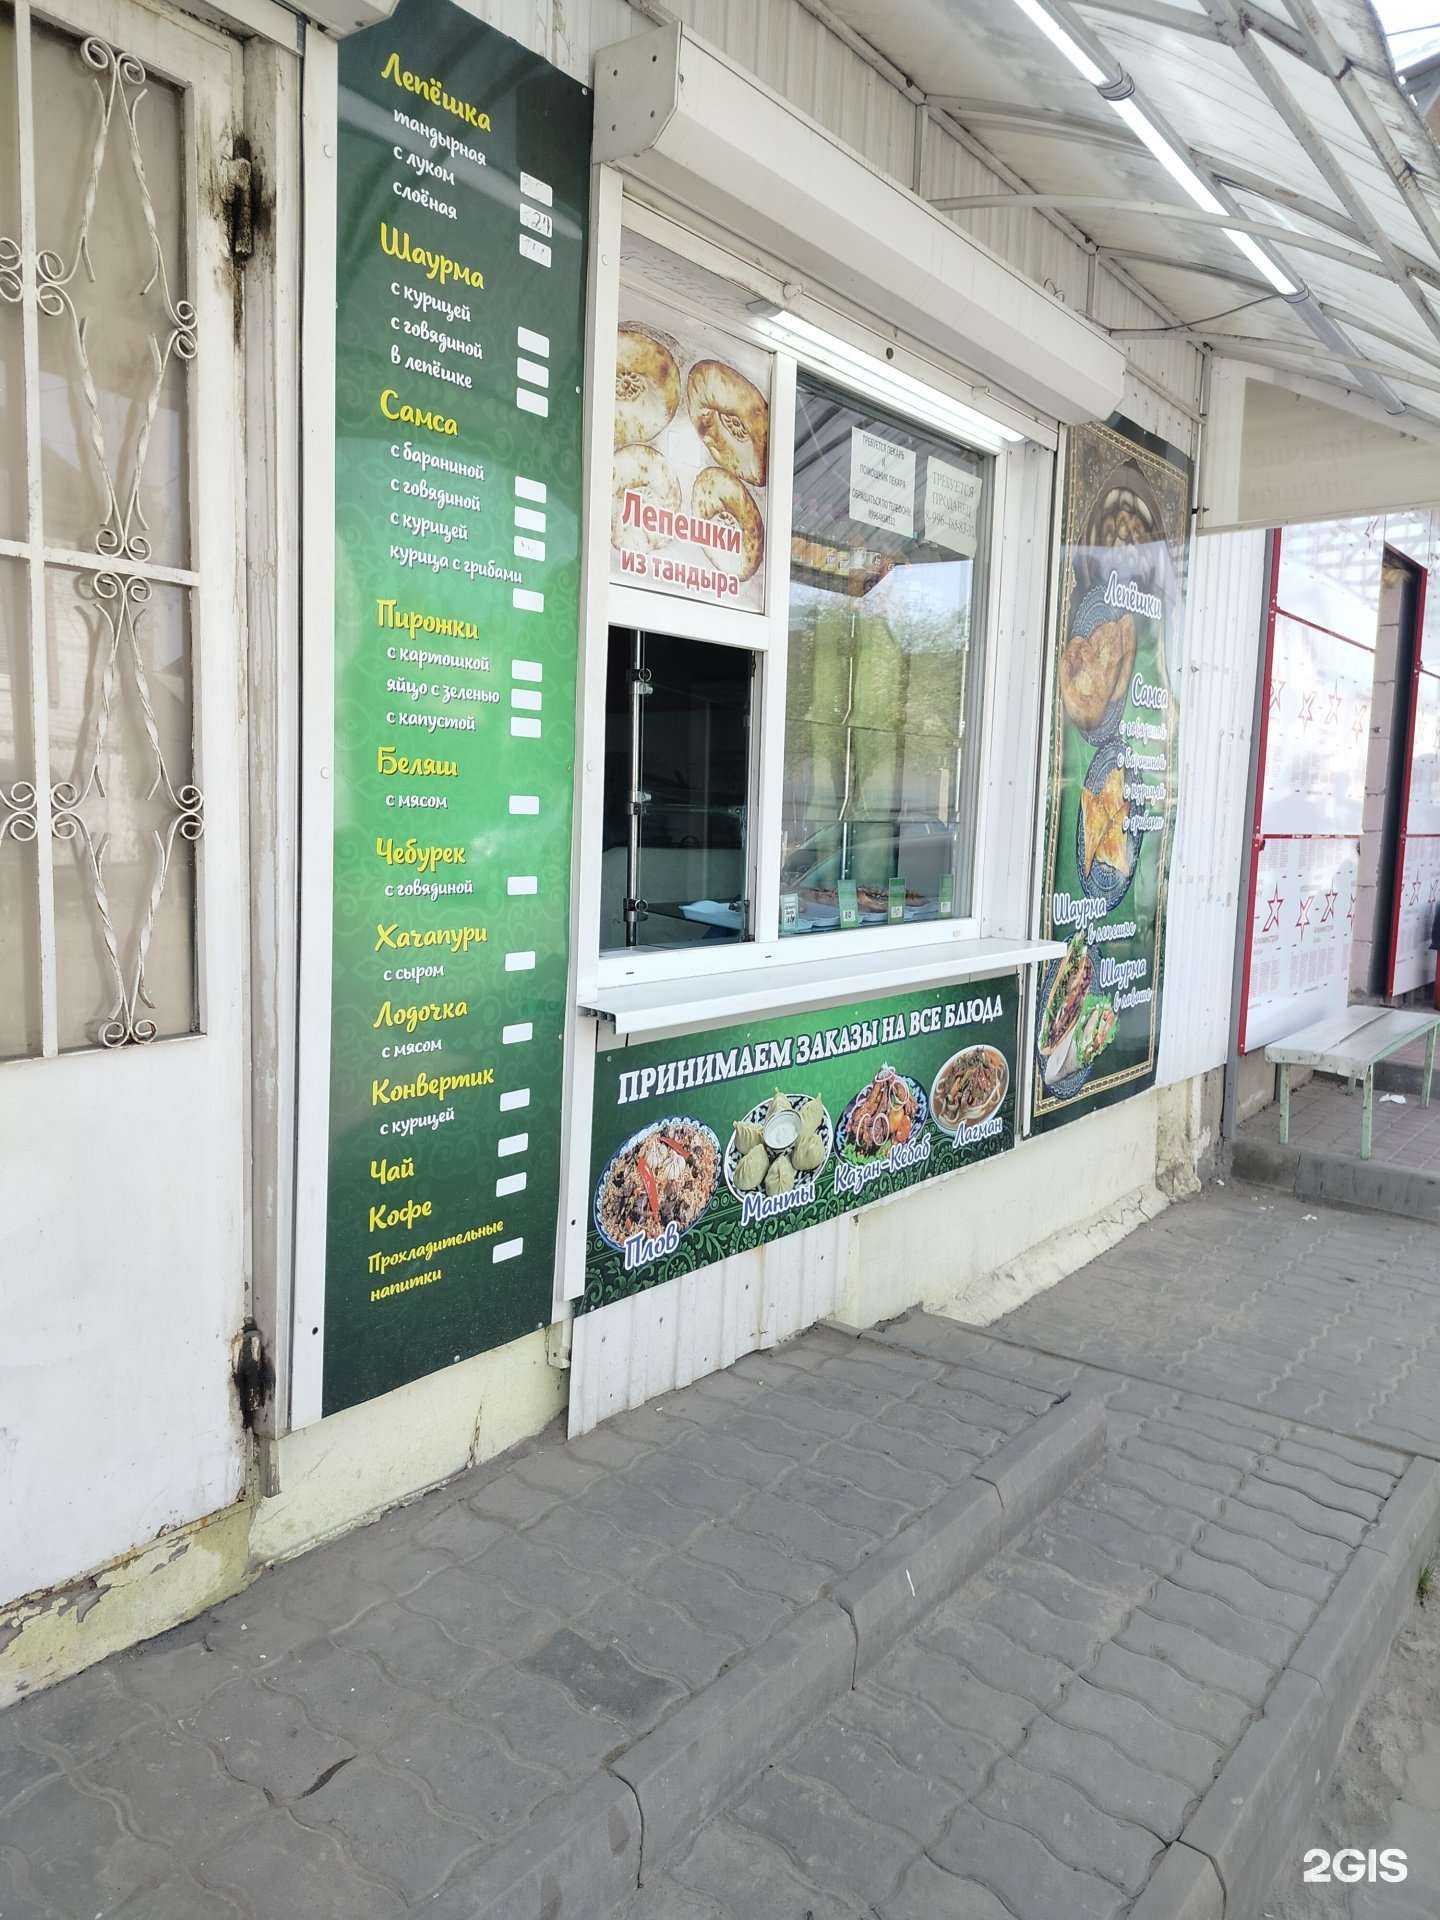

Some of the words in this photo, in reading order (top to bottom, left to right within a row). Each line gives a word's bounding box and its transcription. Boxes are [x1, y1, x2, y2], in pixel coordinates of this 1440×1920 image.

[381, 52, 492, 132] Лепёшка
[393, 108, 487, 166] тандырная
[393, 146, 403, 160] с
[406, 152, 456, 185] луком
[392, 181, 458, 220] слоёная
[380, 222, 485, 290] Шаурма
[390, 281, 401, 296] с
[403, 285, 472, 322] курицей
[390, 316, 401, 330] с
[403, 320, 484, 360] говядиной
[390, 344, 401, 365] в
[404, 355, 473, 389] лепёшке
[380, 389, 459, 436] Самса
[390, 443, 400, 458] с
[403, 441, 485, 481] бараниной
[390, 478, 400, 492] с
[403, 479, 482, 512] говядиной
[390, 511, 400, 526] с
[402, 513, 469, 543] курицей
[622, 491, 743, 554] Лепешки
[389, 545, 449, 573] курица
[452, 556, 461, 570] с
[463, 559, 523, 584] грибами
[620, 549, 648, 576] из
[652, 556, 740, 598] тандыра
[376, 599, 480, 641] Пирожки
[386, 646, 397, 660] с
[399, 647, 491, 672] картошкой
[386, 678, 428, 701] яйцо
[430, 684, 441, 698] с
[442, 686, 501, 704] зеленью
[1131, 673, 1169, 709] Самса
[386, 710, 396, 725] с
[398, 710, 476, 733] капустой
[377, 746, 459, 777] Беляш
[385, 795, 395, 807] с
[398, 794, 448, 809] мясом
[375, 837, 467, 873] Чебурек
[384, 884, 394, 897] с
[396, 879, 474, 902] говядиной
[1053, 893, 1107, 929] Шаурма
[374, 923, 489, 953] Хачапури
[383, 970, 393, 982] с
[395, 965, 446, 984] сыром
[1100, 957, 1147, 989] Шаурма
[372, 1001, 469, 1033] Лодочка
[381, 1045, 391, 1058] с
[393, 1040, 443, 1058] мясом
[617, 1041, 793, 1104] ПРИНИМАЕМ
[796, 1026, 880, 1062] ЗАКАЗЫ
[880, 1020, 908, 1043] НА
[908, 1007, 943, 1037] ВСЕ
[945, 995, 1004, 1026] БЛЮДА
[371, 1068, 496, 1106] Конвертик
[379, 1122, 389, 1135] с
[391, 1108, 456, 1136] курицей
[954, 1117, 1004, 1149] Лагман
[369, 1157, 416, 1185] Чай
[834, 1133, 931, 1194] Казан-Кебаб
[368, 1199, 433, 1233] Кофе
[741, 1184, 816, 1226] Манты
[367, 1219, 504, 1275] Прохладительные
[624, 1222, 681, 1270] Плов
[370, 1269, 443, 1303] напитки
